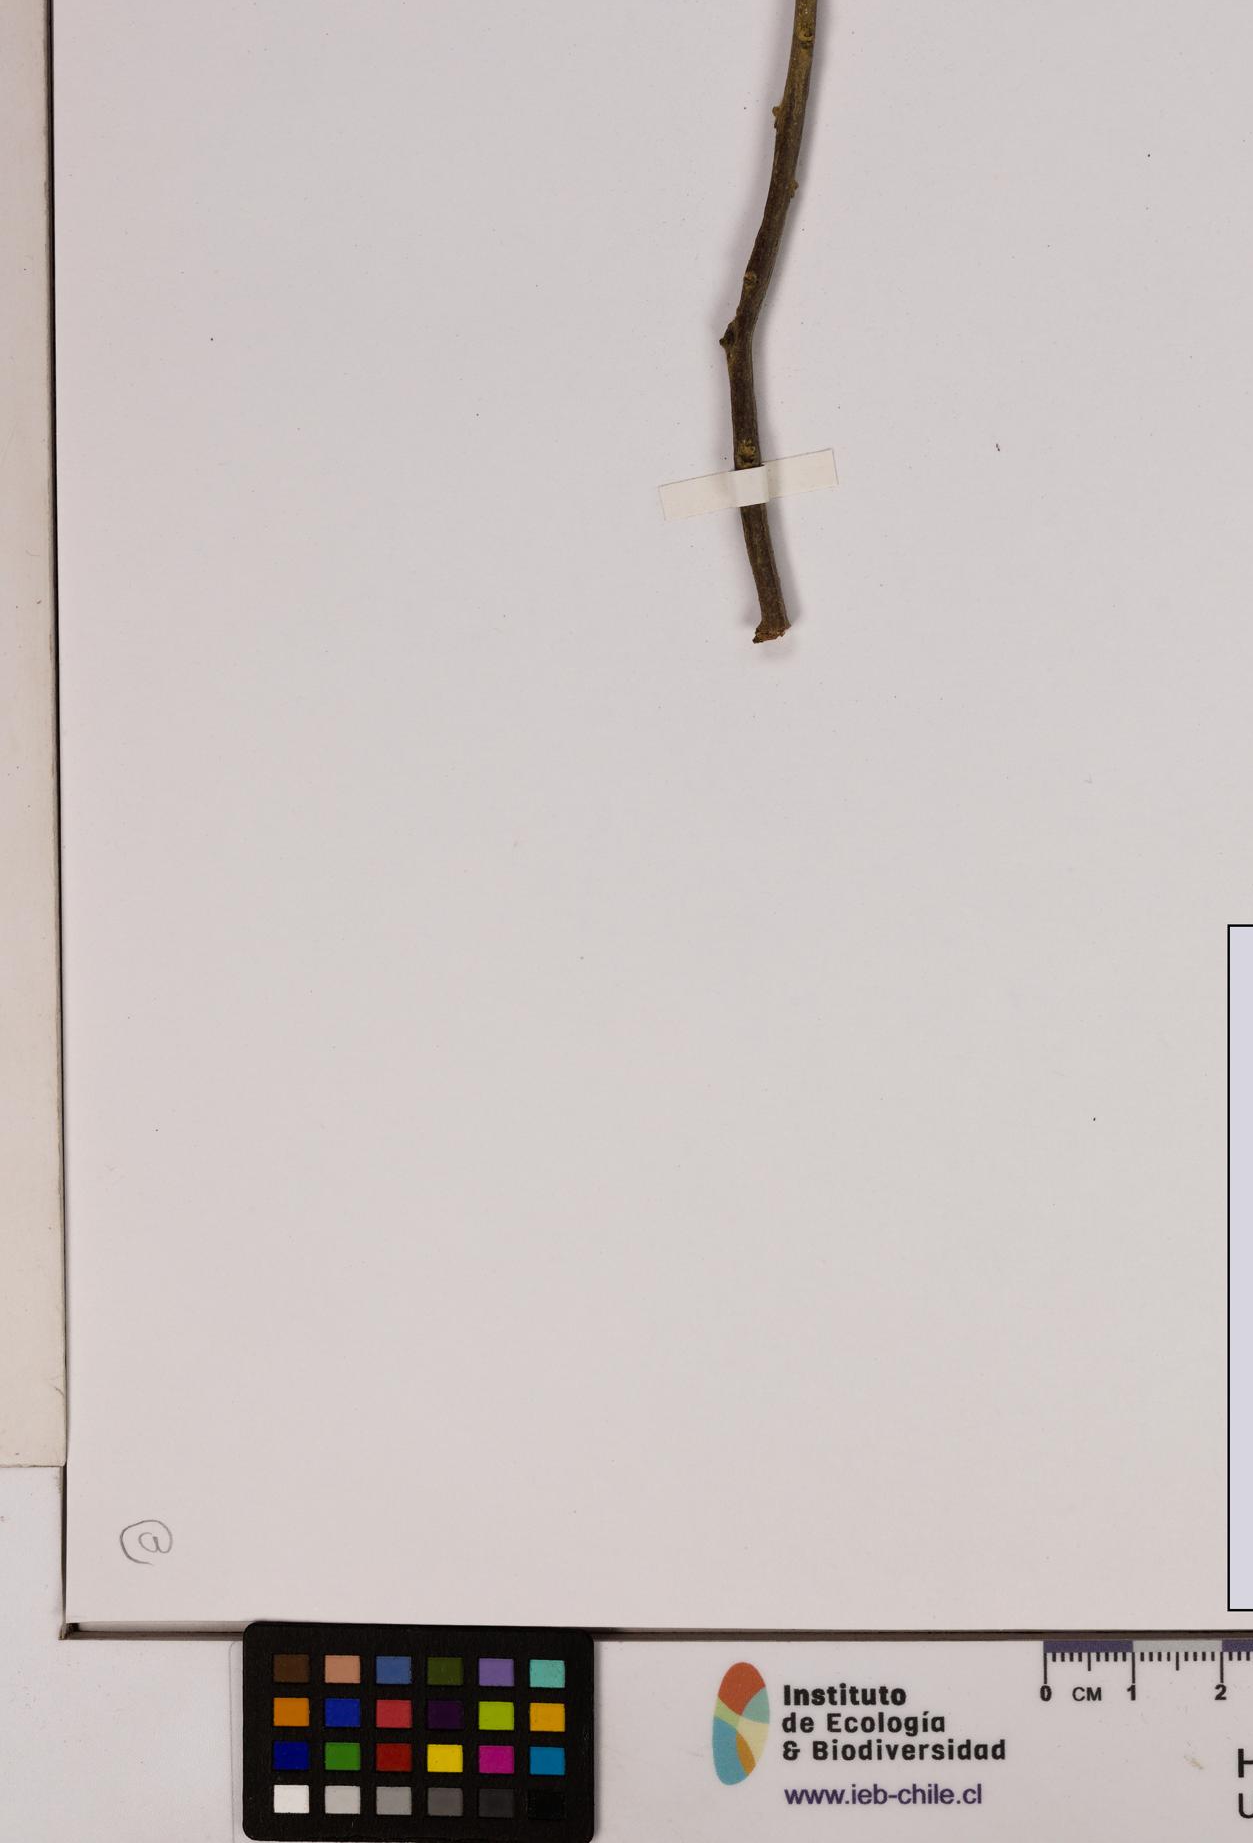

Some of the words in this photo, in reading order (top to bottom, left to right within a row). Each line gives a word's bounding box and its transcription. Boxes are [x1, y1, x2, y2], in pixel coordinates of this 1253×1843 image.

[783, 1682, 907, 1707] Instituto
[1039, 1682, 1053, 1702] 0
[1071, 1686, 1102, 1702] CM
[1126, 1682, 1137, 1702] 1
[1214, 1683, 1227, 1701] 2
[781, 1711, 815, 1734] de
[826, 1710, 946, 1738] Ecología
[782, 1740, 801, 1761] &
[812, 1734, 1006, 1762] Biodiversidad
[783, 1783, 982, 1805] www.ieb-chile.cl
